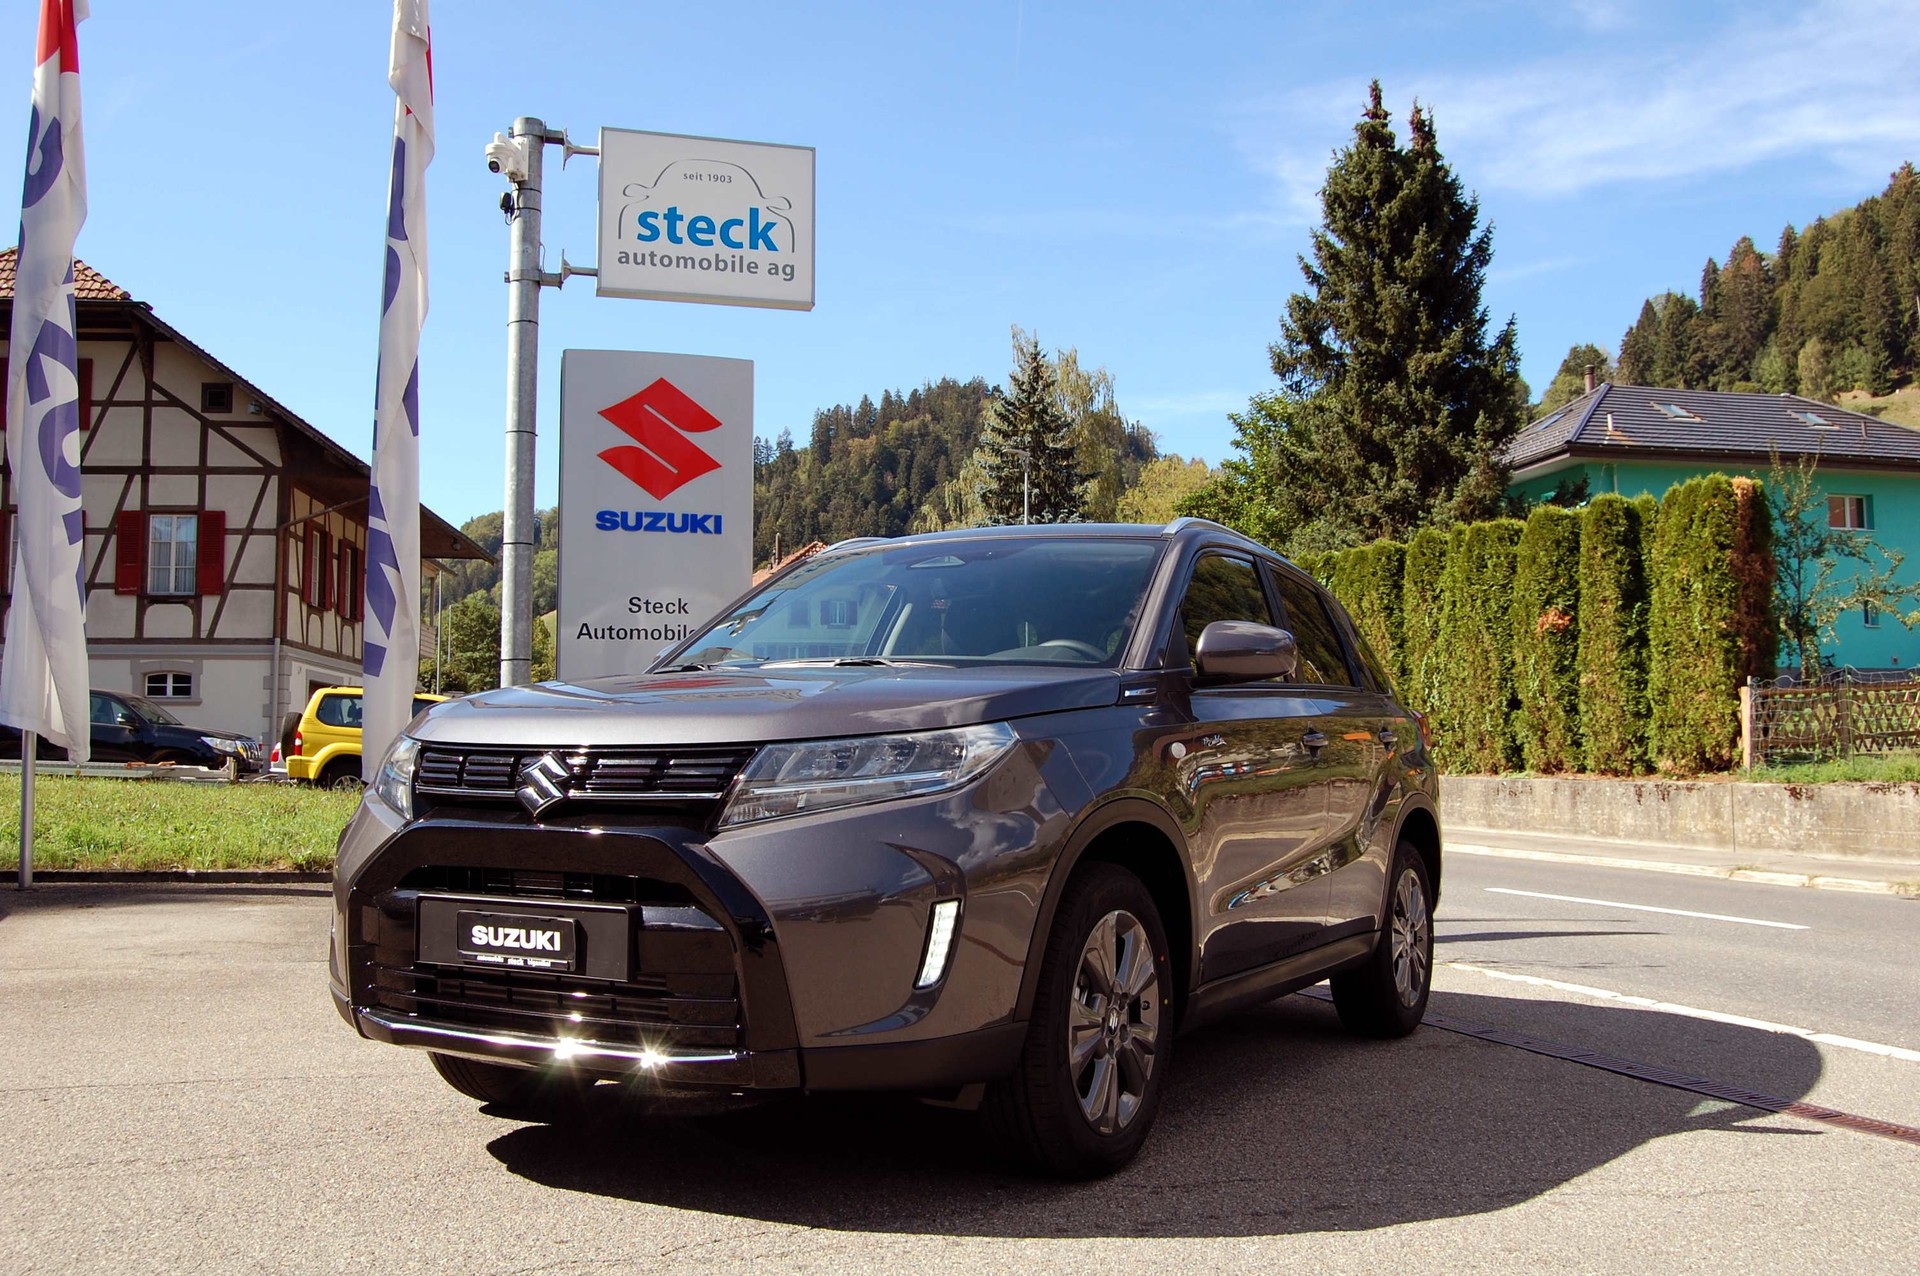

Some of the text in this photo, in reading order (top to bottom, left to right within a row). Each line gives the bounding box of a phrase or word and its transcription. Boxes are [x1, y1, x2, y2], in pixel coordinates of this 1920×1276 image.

[683, 172, 732, 183] seit 1903
[637, 206, 779, 252] steck
[617, 251, 795, 282] automobile ag
[595, 510, 723, 535] SUZUKI
[628, 596, 689, 614] Steck
[576, 623, 696, 641] Automobil
[471, 925, 561, 952] SUZUKI
